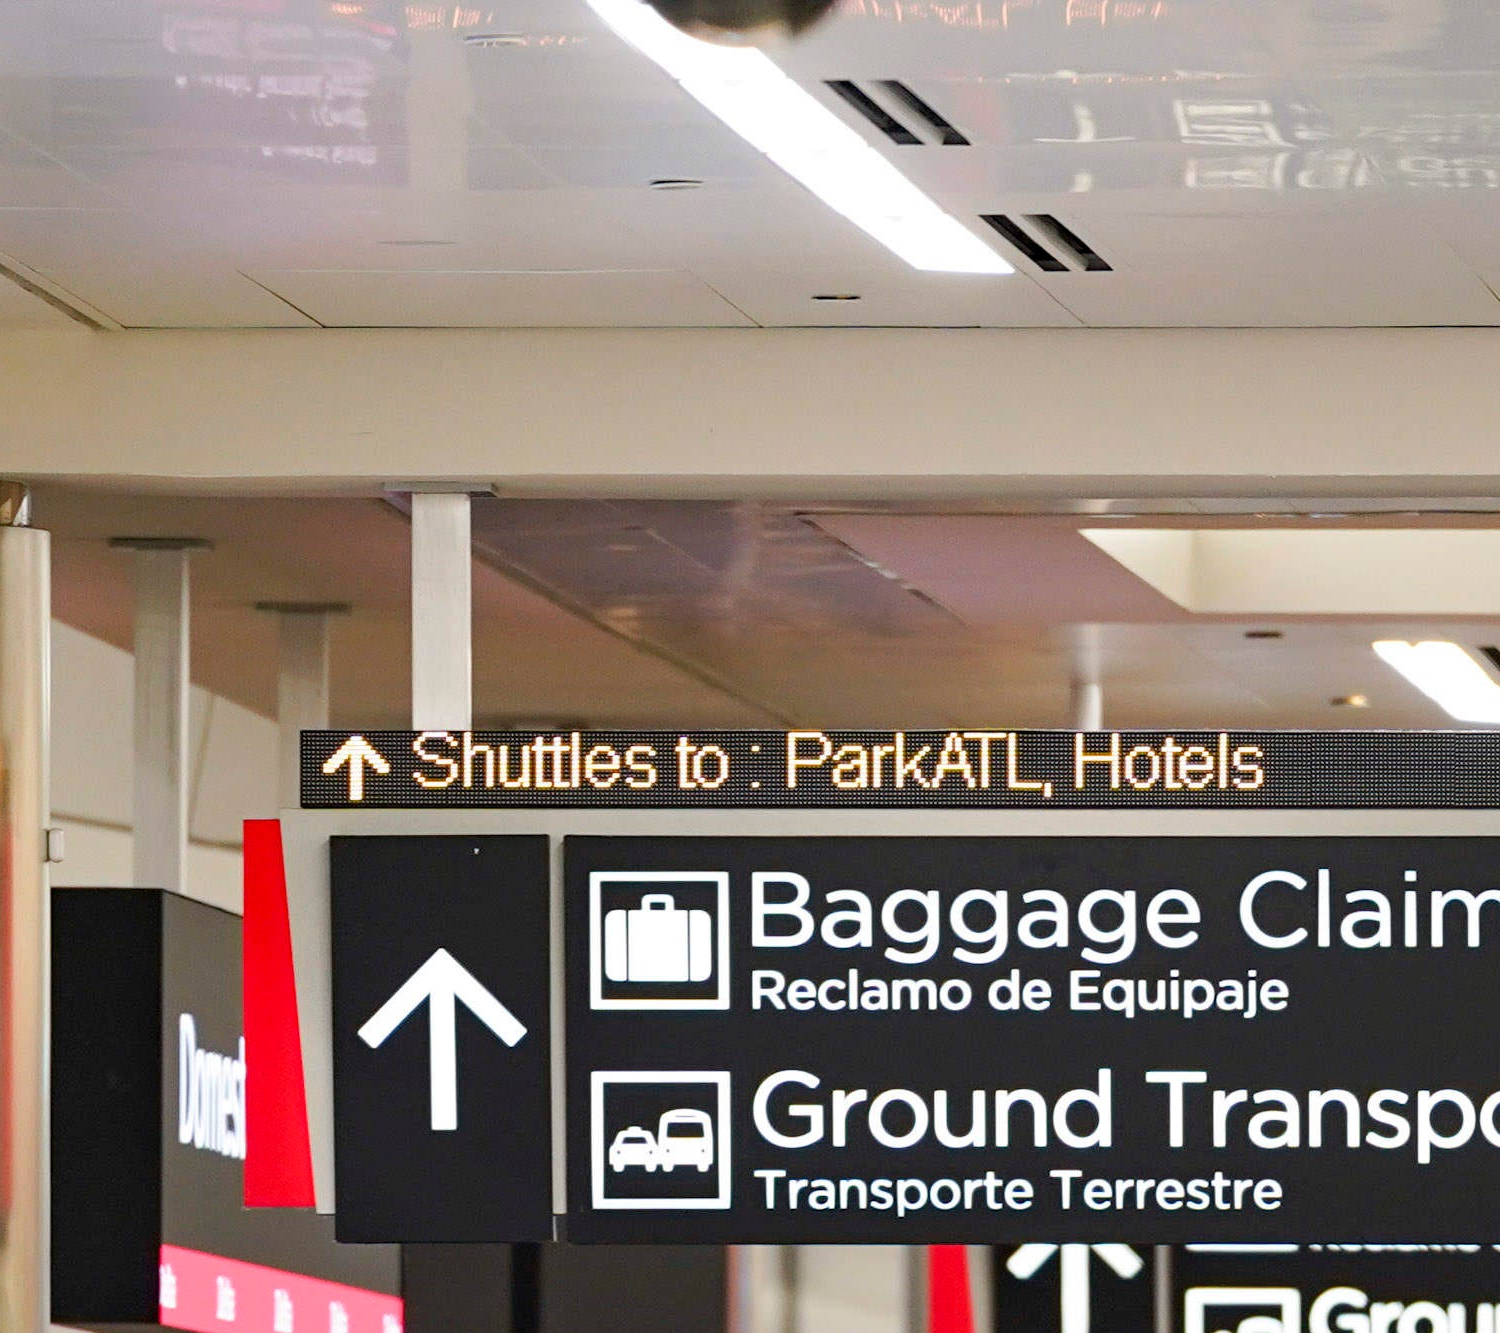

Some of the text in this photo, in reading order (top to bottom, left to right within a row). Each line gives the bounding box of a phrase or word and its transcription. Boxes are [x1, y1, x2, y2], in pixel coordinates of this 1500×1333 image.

[412, 731, 658, 790] Shuttles
[676, 737, 730, 789] to
[786, 732, 1054, 797] ParkATL,
[1073, 732, 1264, 790] Hotels
[752, 872, 1200, 966] Baggage
[752, 969, 1289, 1019] Reclamo de Equipaje
[753, 1068, 1111, 1149] Ground
[754, 1170, 1282, 1218] Transporte Terrestre
